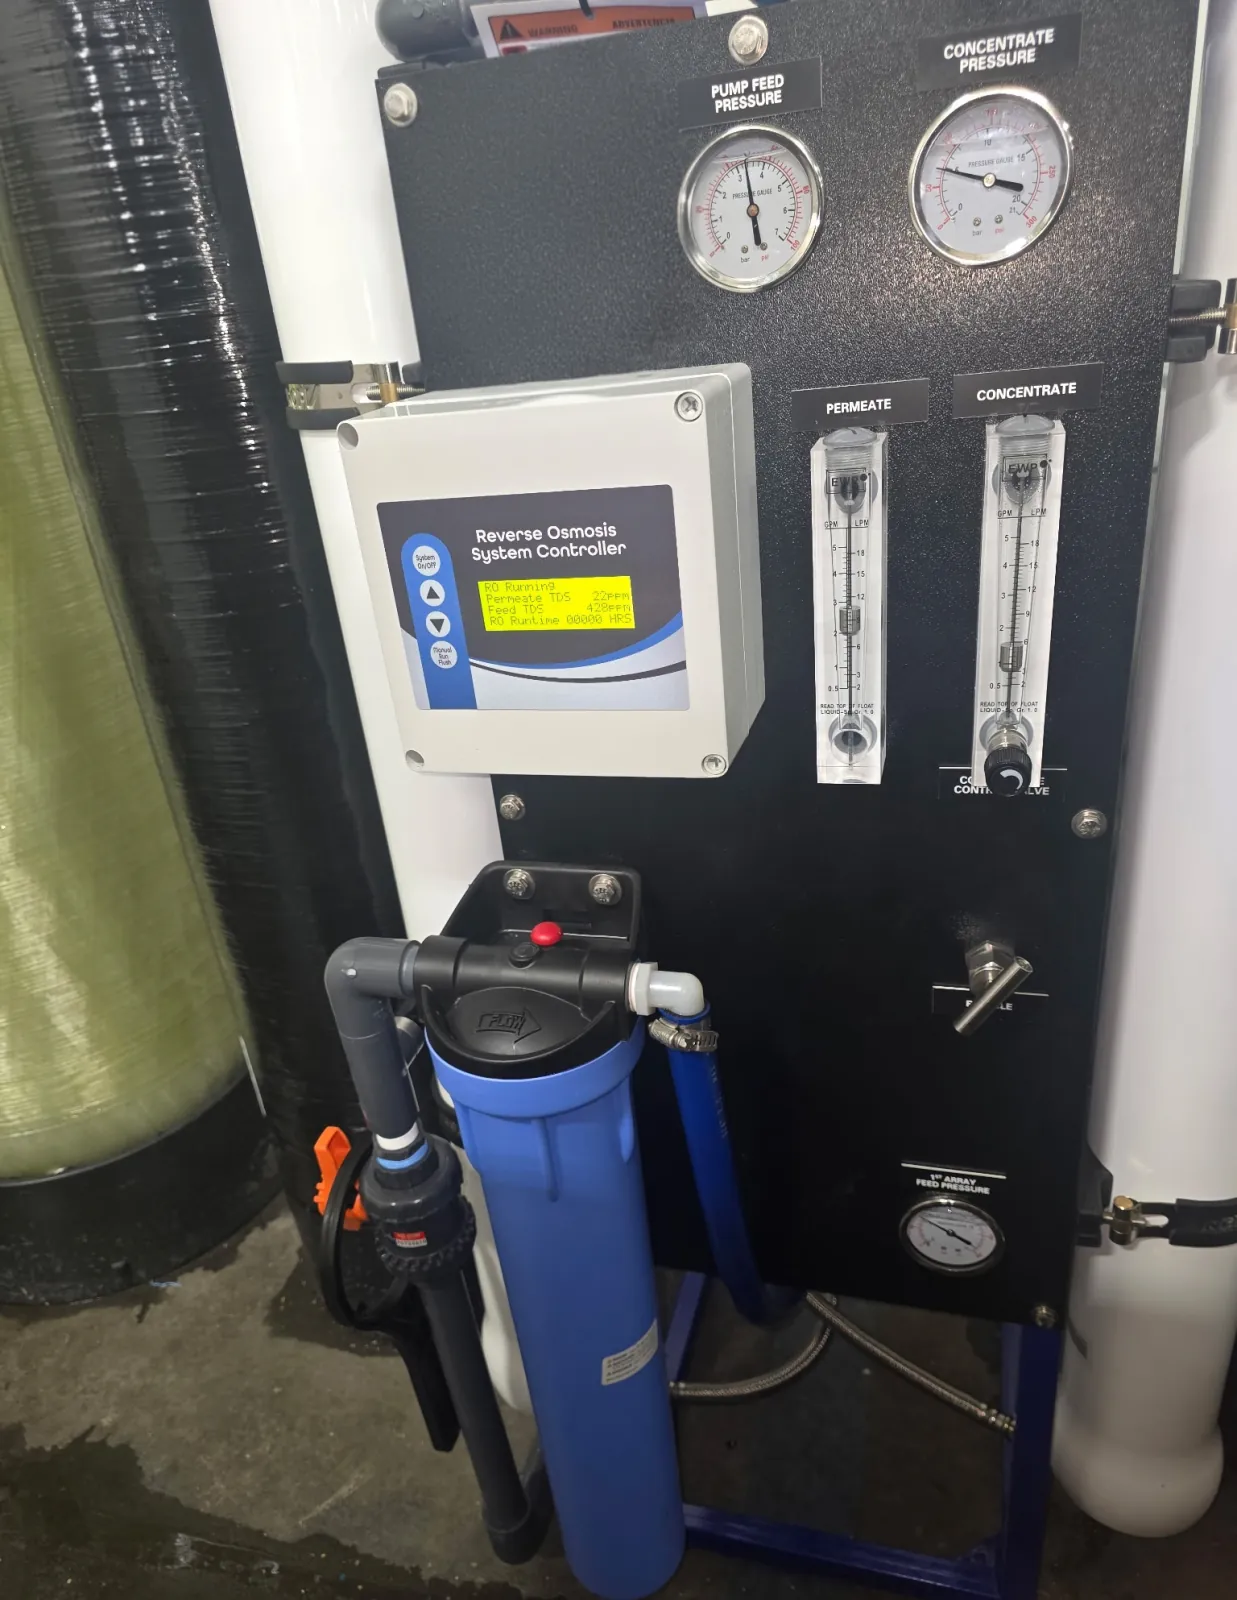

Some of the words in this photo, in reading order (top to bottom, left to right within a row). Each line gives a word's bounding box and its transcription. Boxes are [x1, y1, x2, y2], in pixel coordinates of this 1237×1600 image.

[944, 28, 1054, 59] CONCENTRATE
[960, 48, 1036, 73] PRESSURE
[712, 80, 748, 98] PUMP
[752, 74, 784, 92] FEED
[715, 90, 782, 113] PRESSURE
[1017, 153, 1026, 162] 15
[757, 188, 772, 196] GAUGE
[1026, 216, 1037, 228] 300
[977, 382, 1077, 401] CONCENTRATE
[826, 398, 892, 414] PERMEATE
[1008, 463, 1038, 474] EWP
[476, 529, 542, 543] Reverse
[547, 522, 617, 540] Osmosis
[472, 546, 532, 564] System
[537, 540, 626, 558] Controller
[485, 582, 499, 592] RO
[505, 581, 555, 592] Running
[486, 594, 542, 604] Permeate
[549, 592, 571, 602] TDS
[593, 591, 630, 601] 22ppm
[488, 605, 516, 614] Feed
[524, 604, 544, 614] TDS
[587, 603, 631, 612] 428ppm
[490, 616, 504, 626] RO
[511, 615, 560, 625] Runtime
[609, 614, 632, 624] HRS
[954, 785, 993, 794] CONTR
[489, 1014, 525, 1036] FLOW
[916, 1178, 939, 1188] FEED
[941, 1182, 990, 1195] PRESSURE
[944, 1176, 976, 1185] ARRAY
